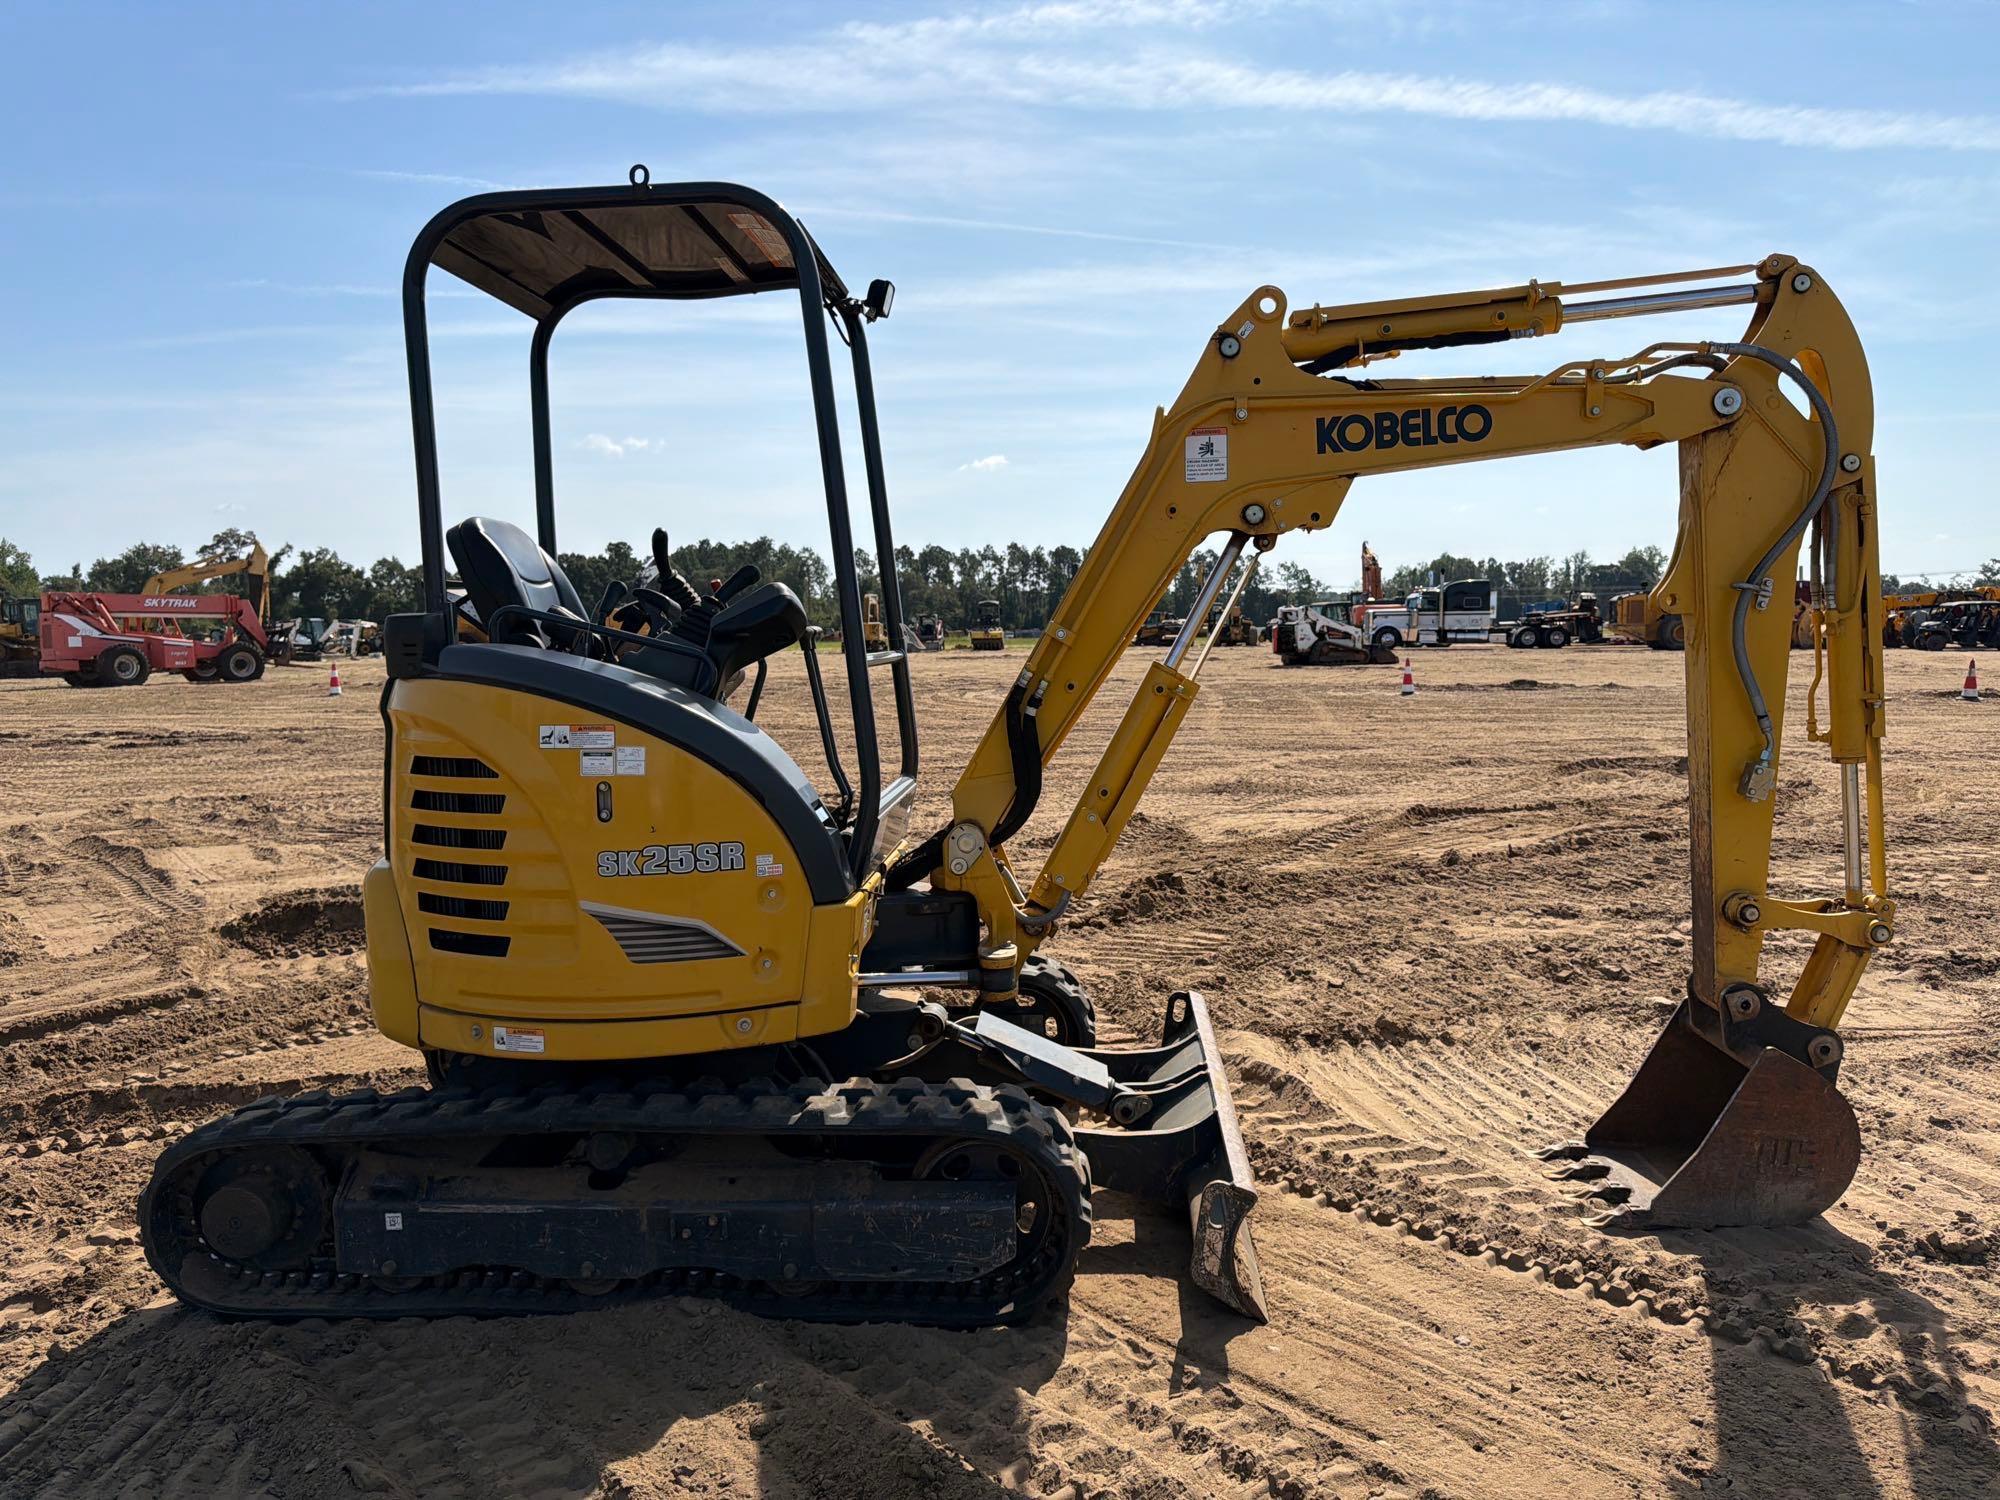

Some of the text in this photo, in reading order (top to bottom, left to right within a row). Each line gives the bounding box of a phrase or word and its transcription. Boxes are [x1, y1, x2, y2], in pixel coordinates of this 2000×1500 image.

[1316, 404, 1492, 454] KOBELCO
[144, 599, 197, 608] SKYTRAK
[597, 842, 745, 877] SK25SR
